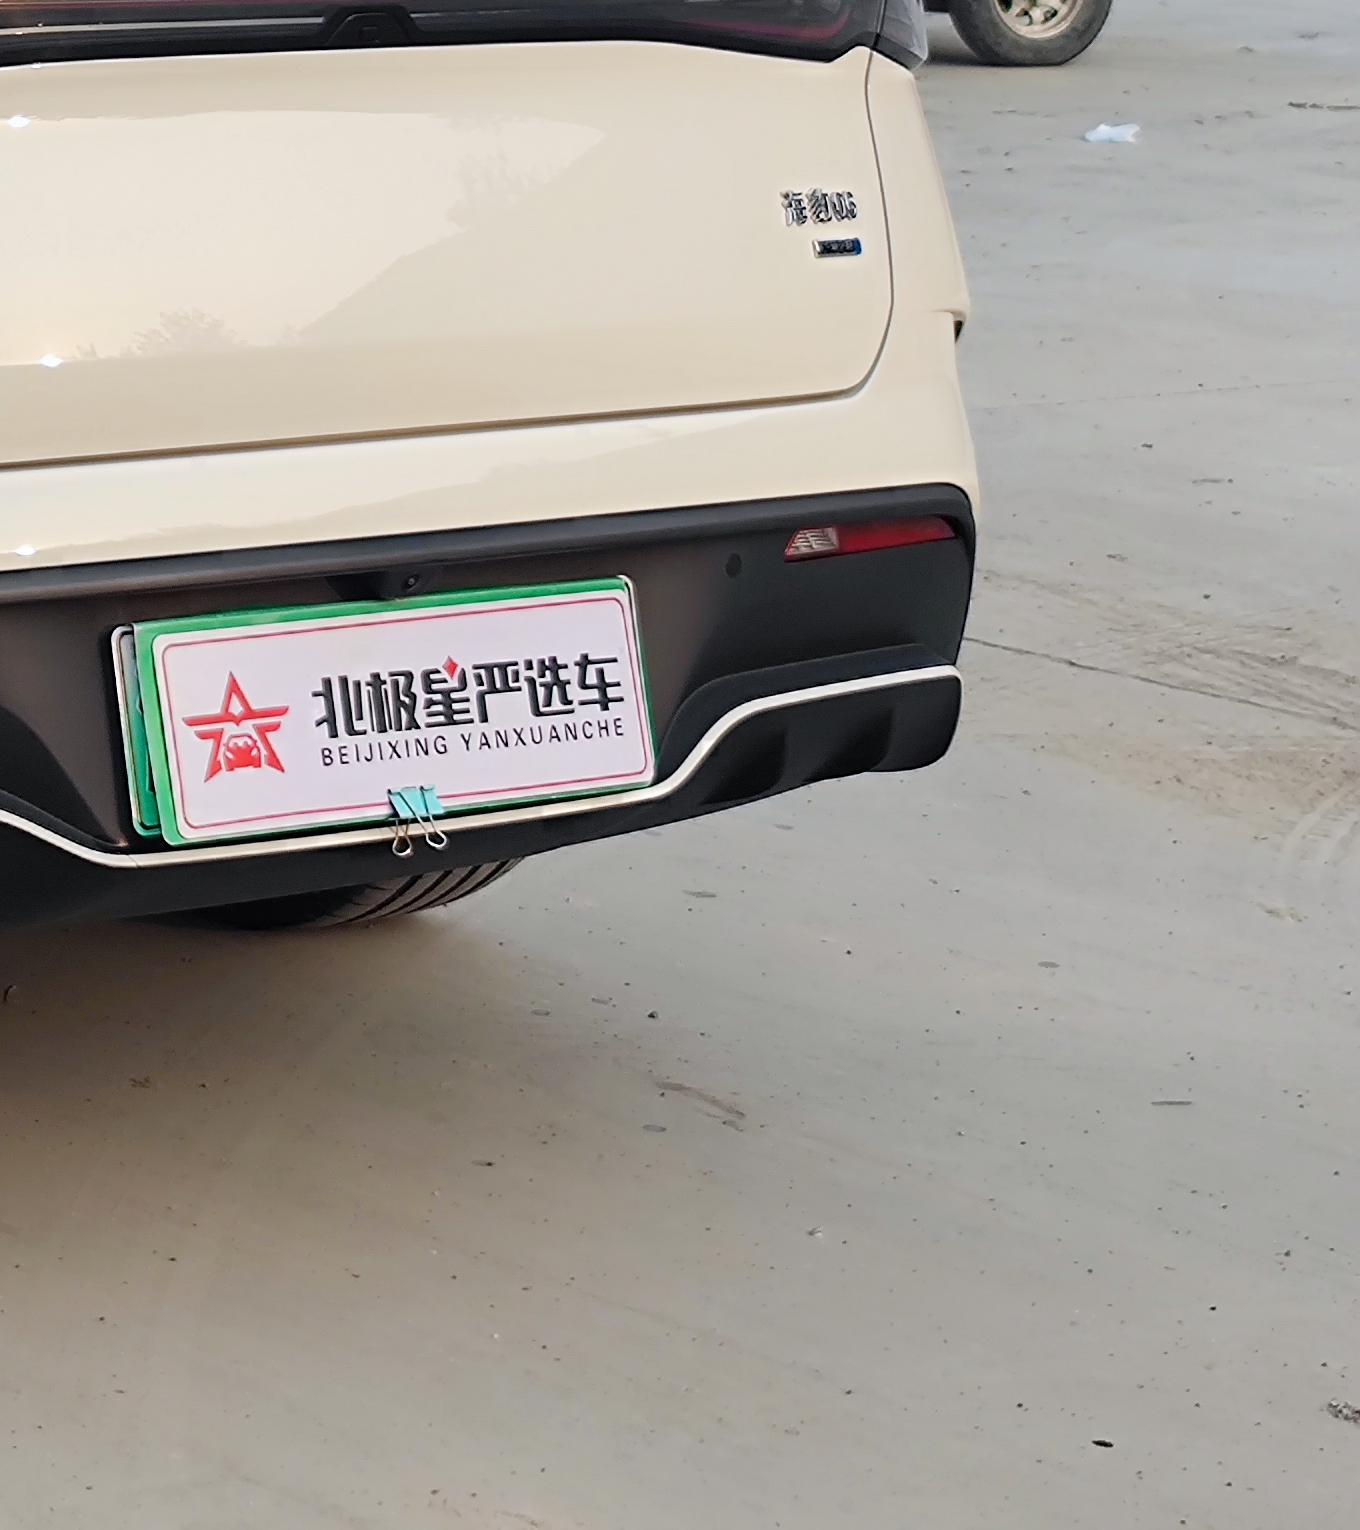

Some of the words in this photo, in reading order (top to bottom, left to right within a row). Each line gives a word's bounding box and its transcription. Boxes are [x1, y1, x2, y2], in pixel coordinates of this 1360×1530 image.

[311, 653, 625, 739] 北极星严选车
[320, 735, 449, 767] BEIJIXING
[460, 717, 625, 752] YANXUANCHE
